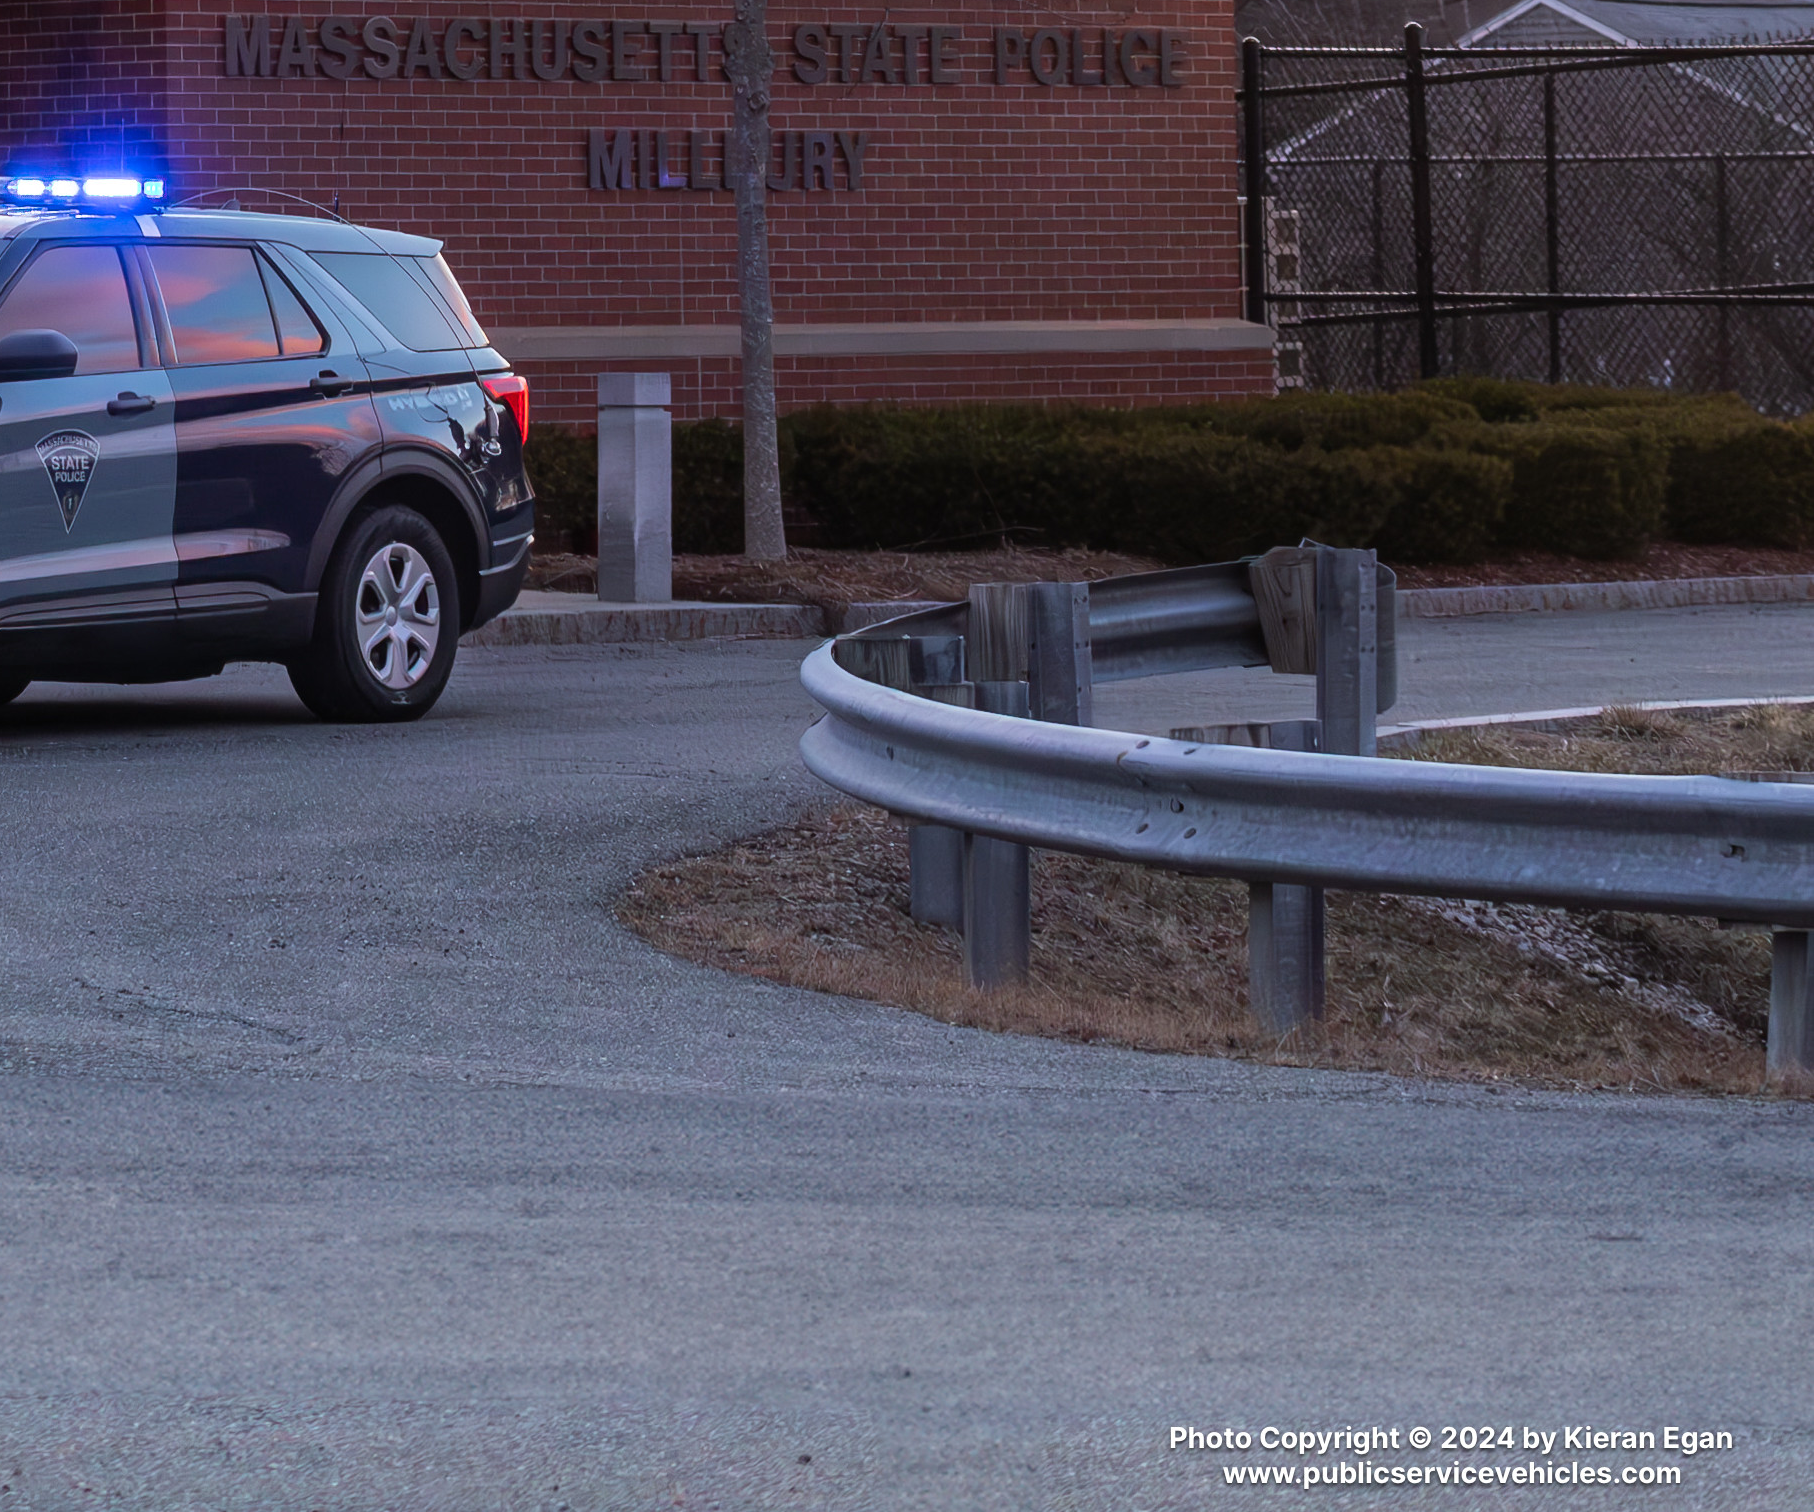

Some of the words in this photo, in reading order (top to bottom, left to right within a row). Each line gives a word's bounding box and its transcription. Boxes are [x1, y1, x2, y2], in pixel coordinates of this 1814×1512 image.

[794, 22, 963, 85] STATE
[995, 27, 1187, 87] POLICE
[51, 455, 89, 470] STATE
[55, 471, 86, 483] POLICE
